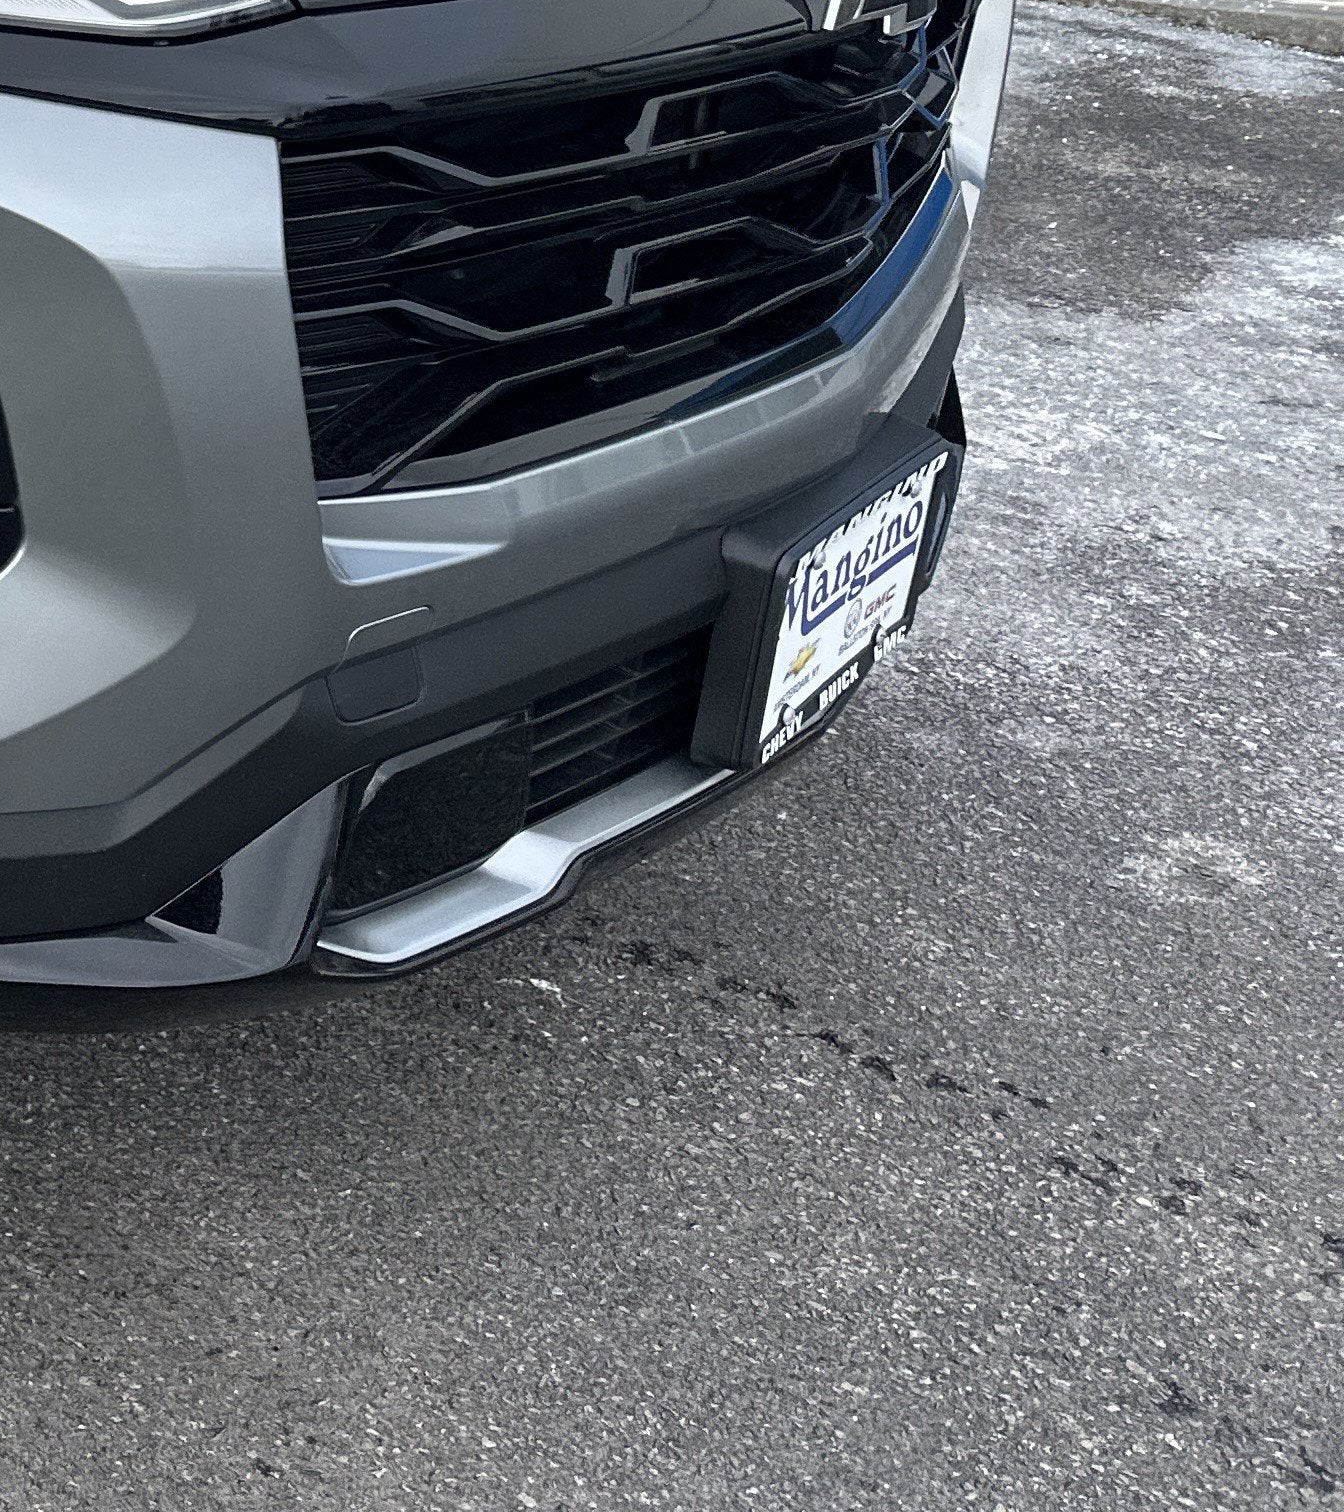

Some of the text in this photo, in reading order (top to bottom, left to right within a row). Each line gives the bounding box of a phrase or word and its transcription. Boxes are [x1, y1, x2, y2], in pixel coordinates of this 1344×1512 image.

[784, 500, 924, 636] Mangino
[864, 583, 897, 620] GMC
[761, 710, 804, 764] CHEVY
[819, 662, 860, 711] BUICK
